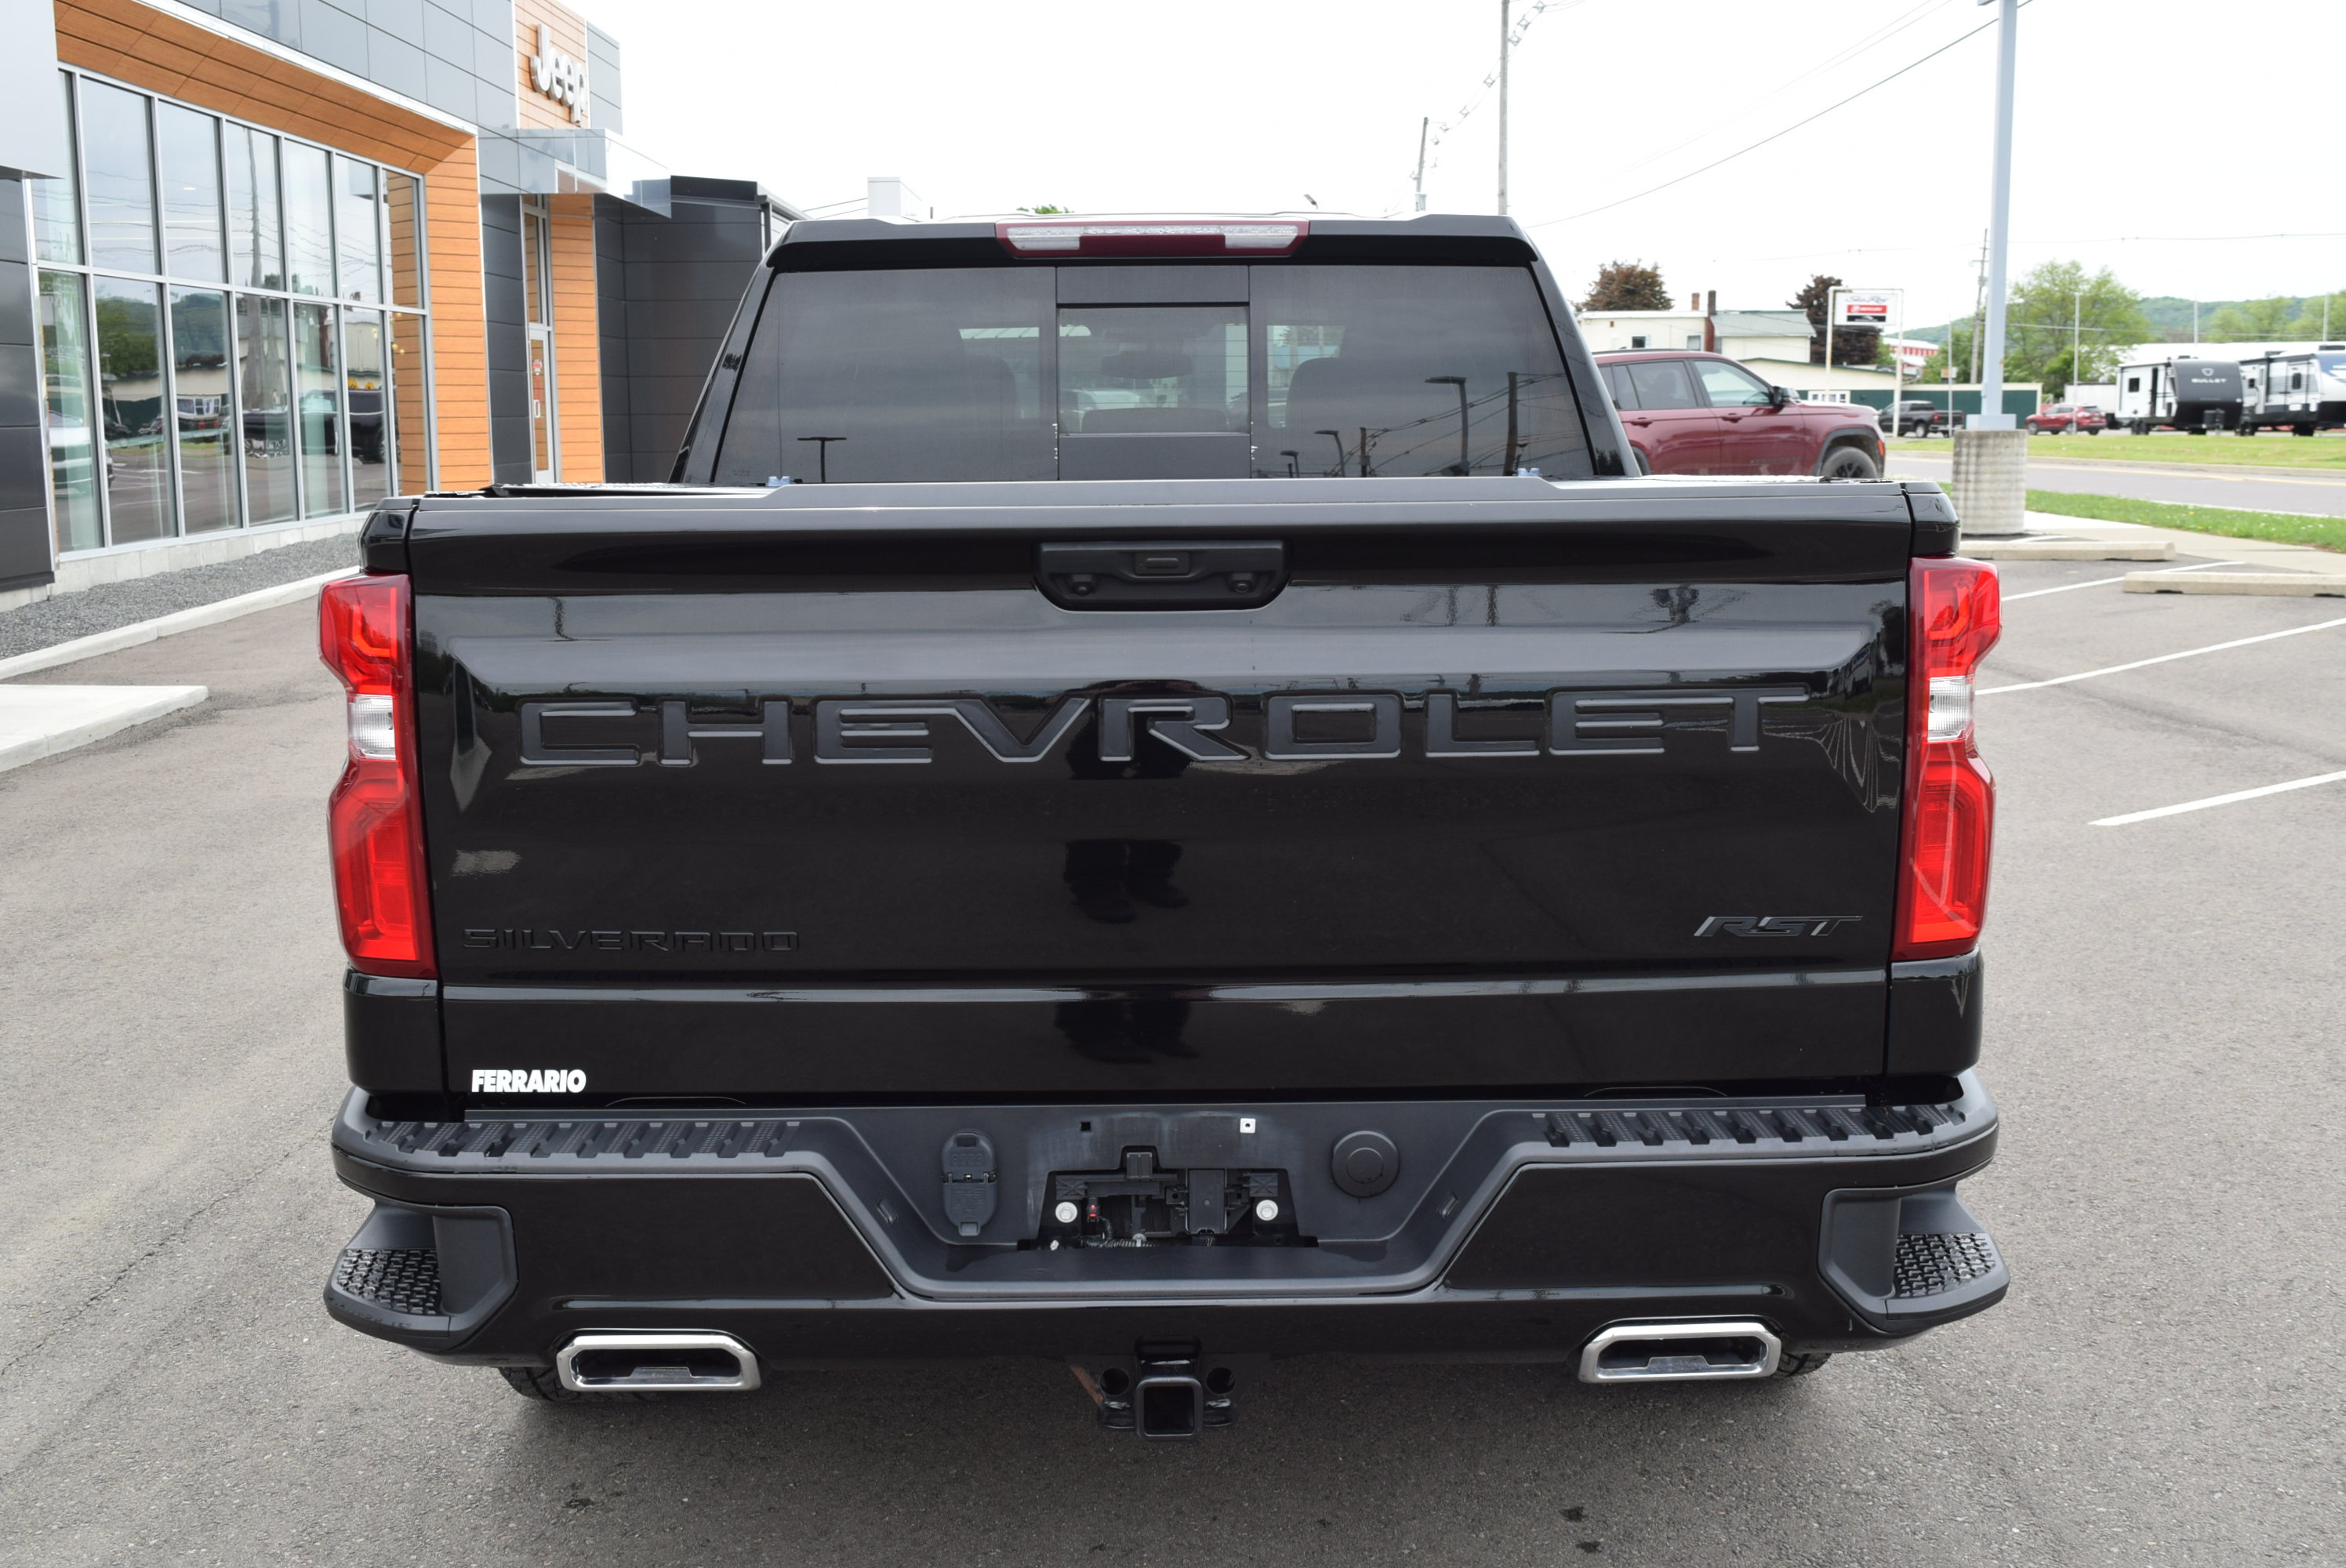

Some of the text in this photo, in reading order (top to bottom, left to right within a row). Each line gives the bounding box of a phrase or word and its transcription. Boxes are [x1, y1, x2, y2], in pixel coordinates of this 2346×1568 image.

[530, 24, 587, 126] Jeep
[517, 686, 1811, 765] CHEVROLET
[1692, 916, 1864, 937] RST
[463, 927, 800, 952] SILVERADO
[471, 1069, 586, 1093] FERRARIO
